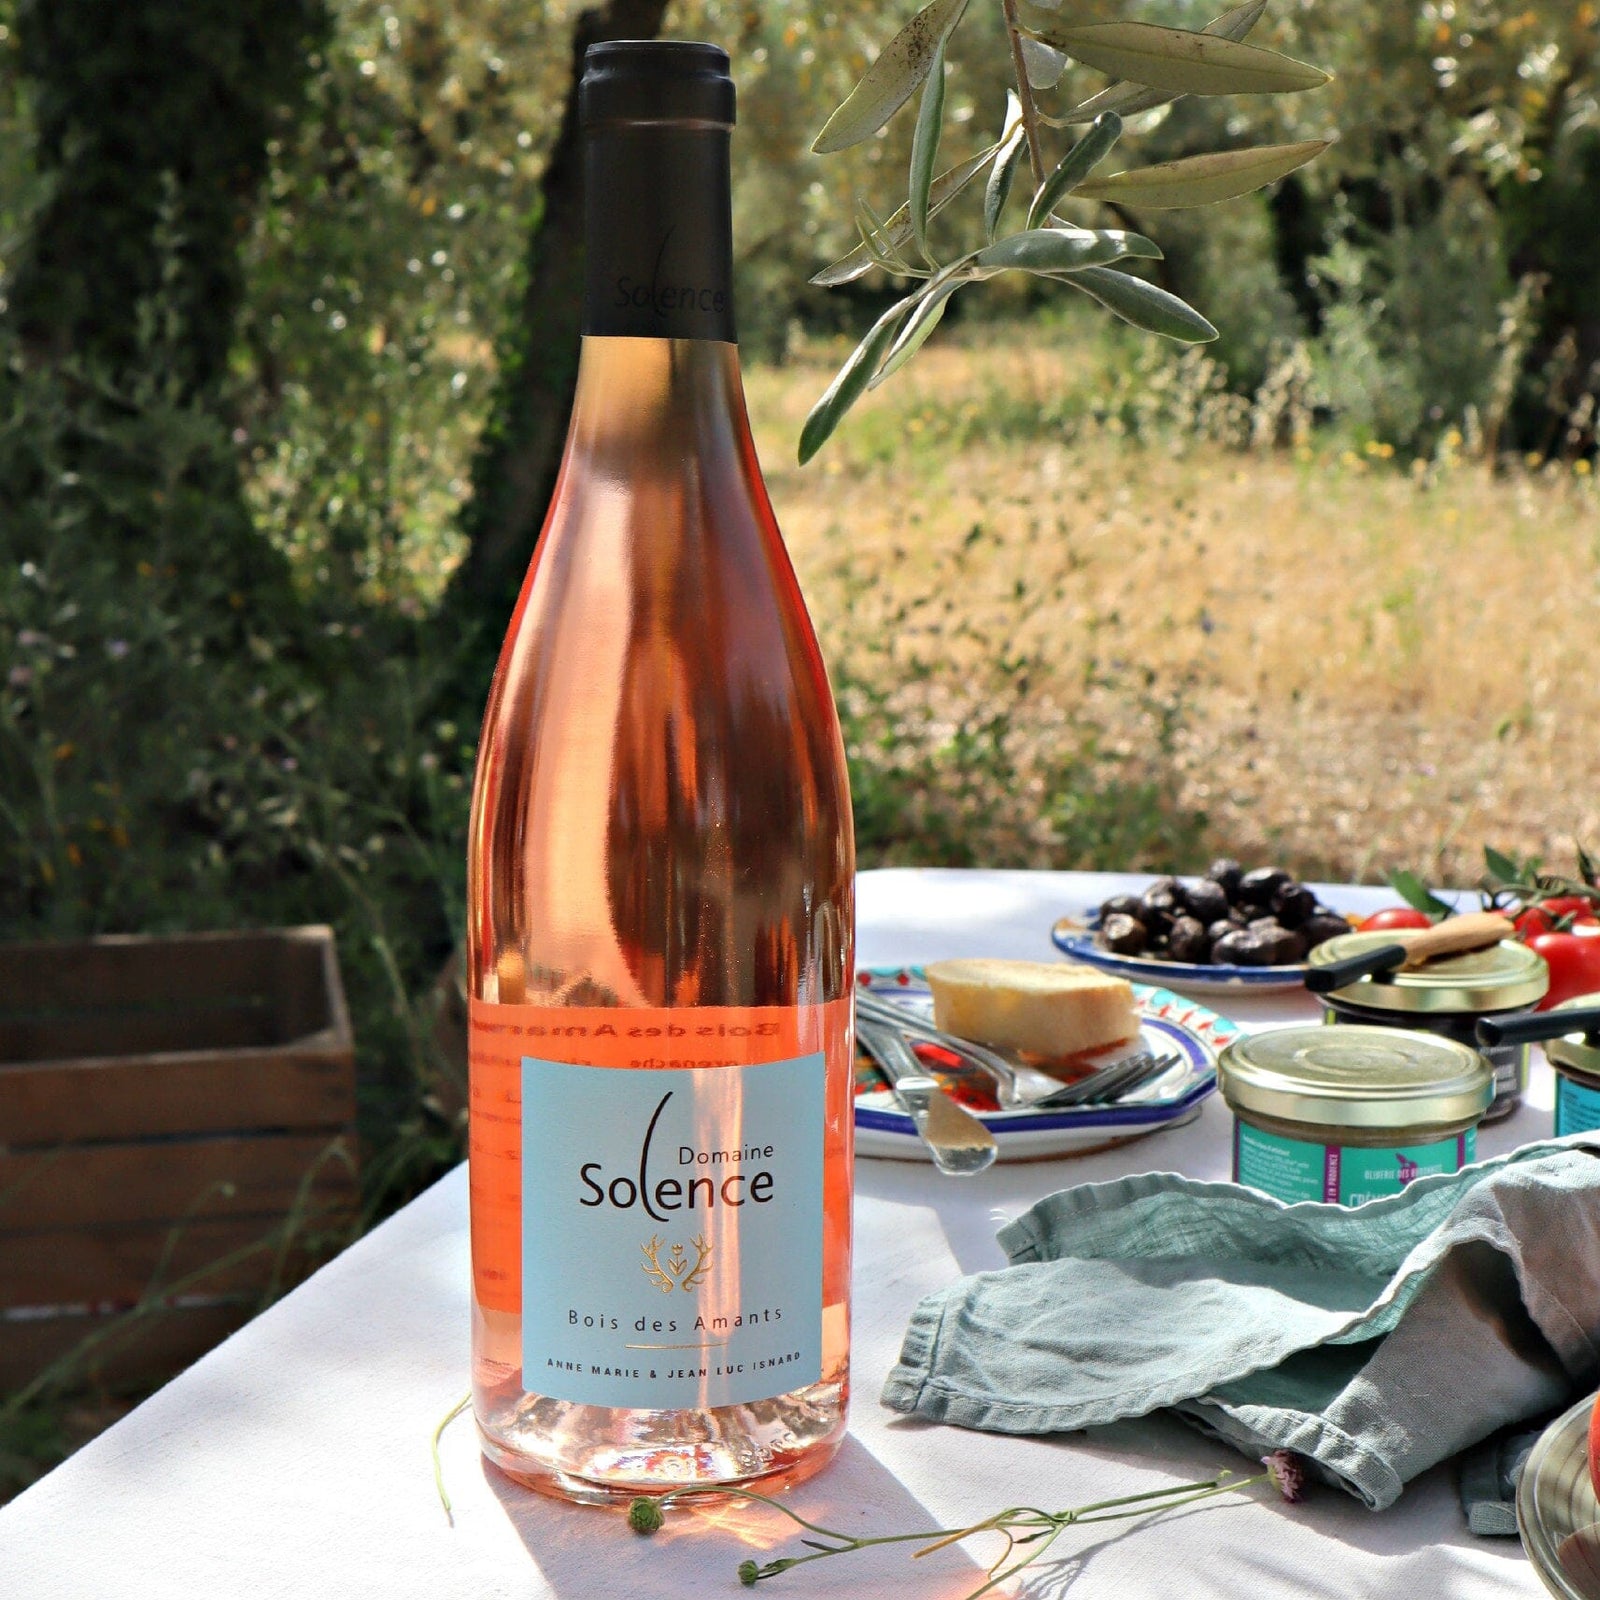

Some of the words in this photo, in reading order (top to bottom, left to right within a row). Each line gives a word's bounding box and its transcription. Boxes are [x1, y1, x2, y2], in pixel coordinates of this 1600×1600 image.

[615, 224, 726, 319] Solence
[579, 1091, 774, 1222] Solence
[679, 1144, 774, 1165] Domaine
[568, 1309, 618, 1330] Bois
[634, 1316, 677, 1332] des
[694, 1307, 782, 1331] Amants
[547, 1358, 582, 1372] ANNE
[591, 1366, 640, 1378] MARIE
[649, 1370, 657, 1379] &
[668, 1369, 707, 1379] JEAN
[716, 1364, 744, 1376] LUC
[753, 1350, 801, 1370] ISNARD
